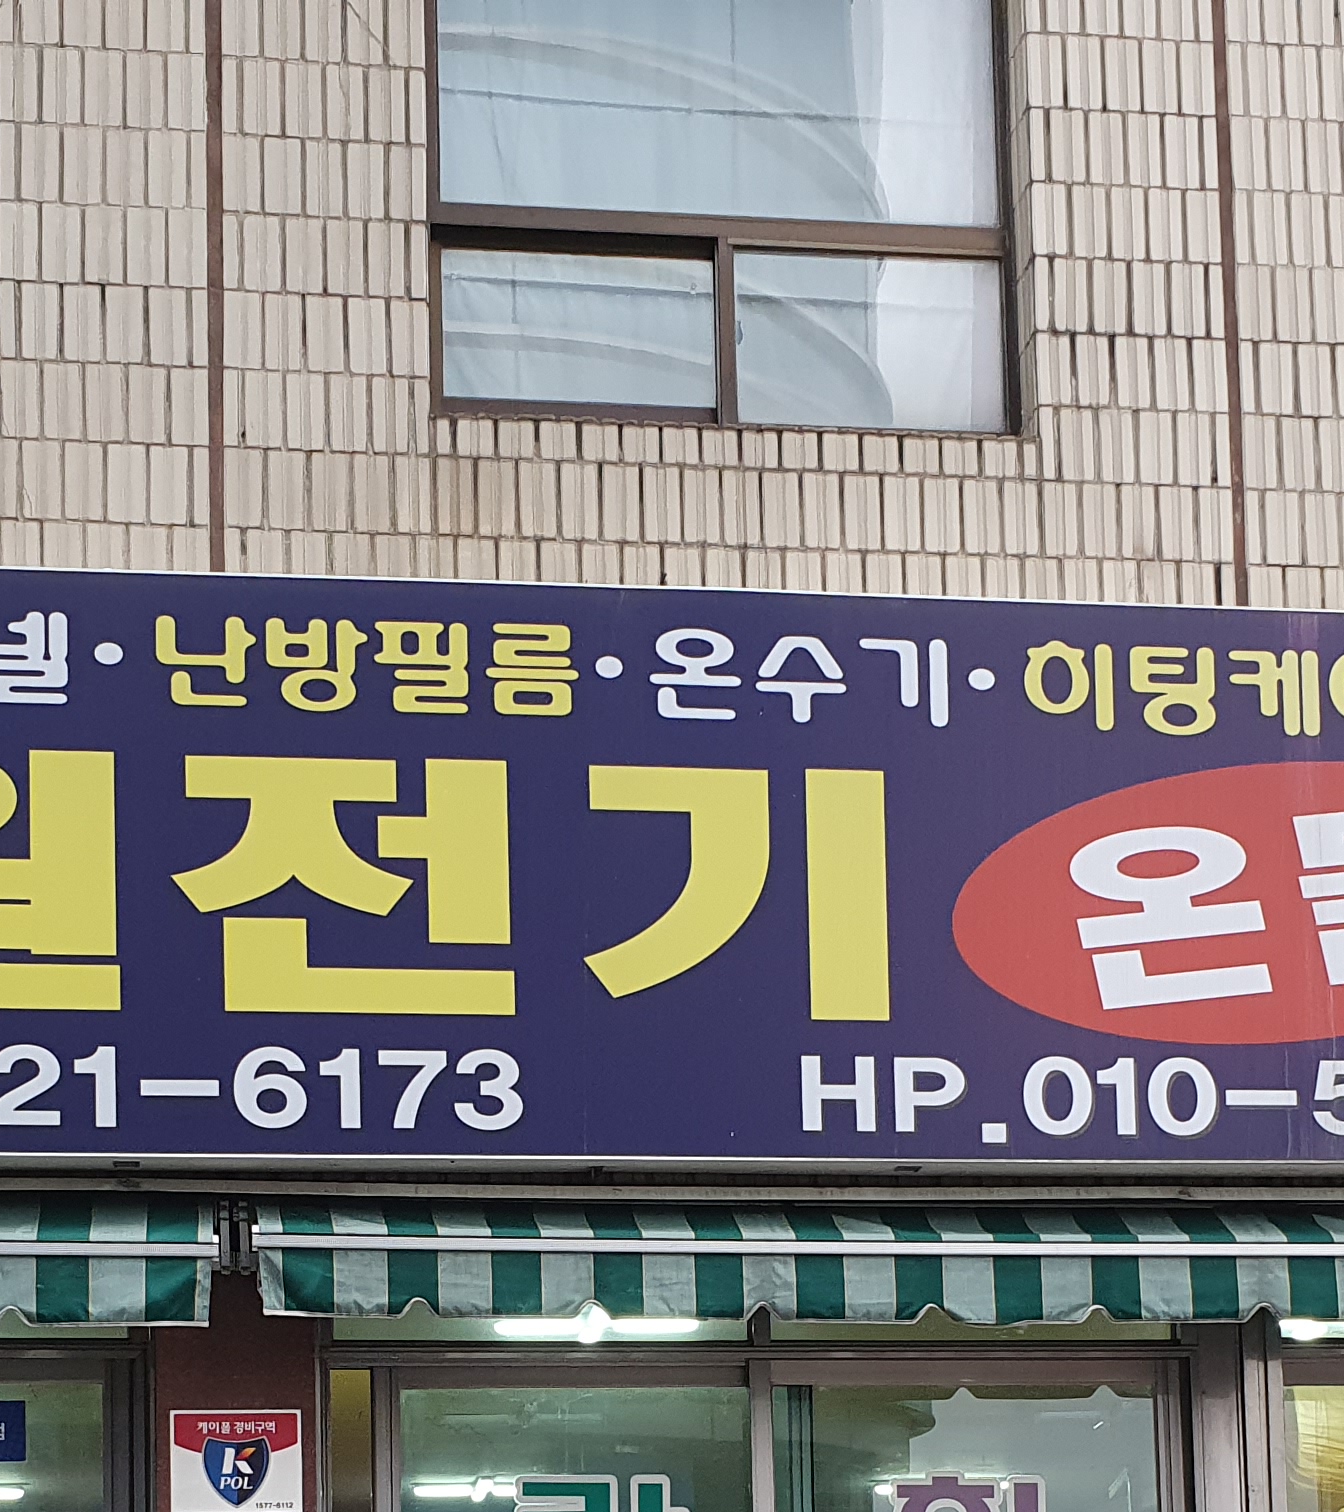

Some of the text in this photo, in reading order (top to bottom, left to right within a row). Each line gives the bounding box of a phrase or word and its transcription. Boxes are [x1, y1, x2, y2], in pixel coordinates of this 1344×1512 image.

[156, 616, 578, 716] 난방필름
[649, 628, 949, 728] 온수기
[196, 1421, 276, 1434] 케이폴 경비구역
[221, 1447, 256, 1474] K
[219, 1476, 253, 1490] POL
